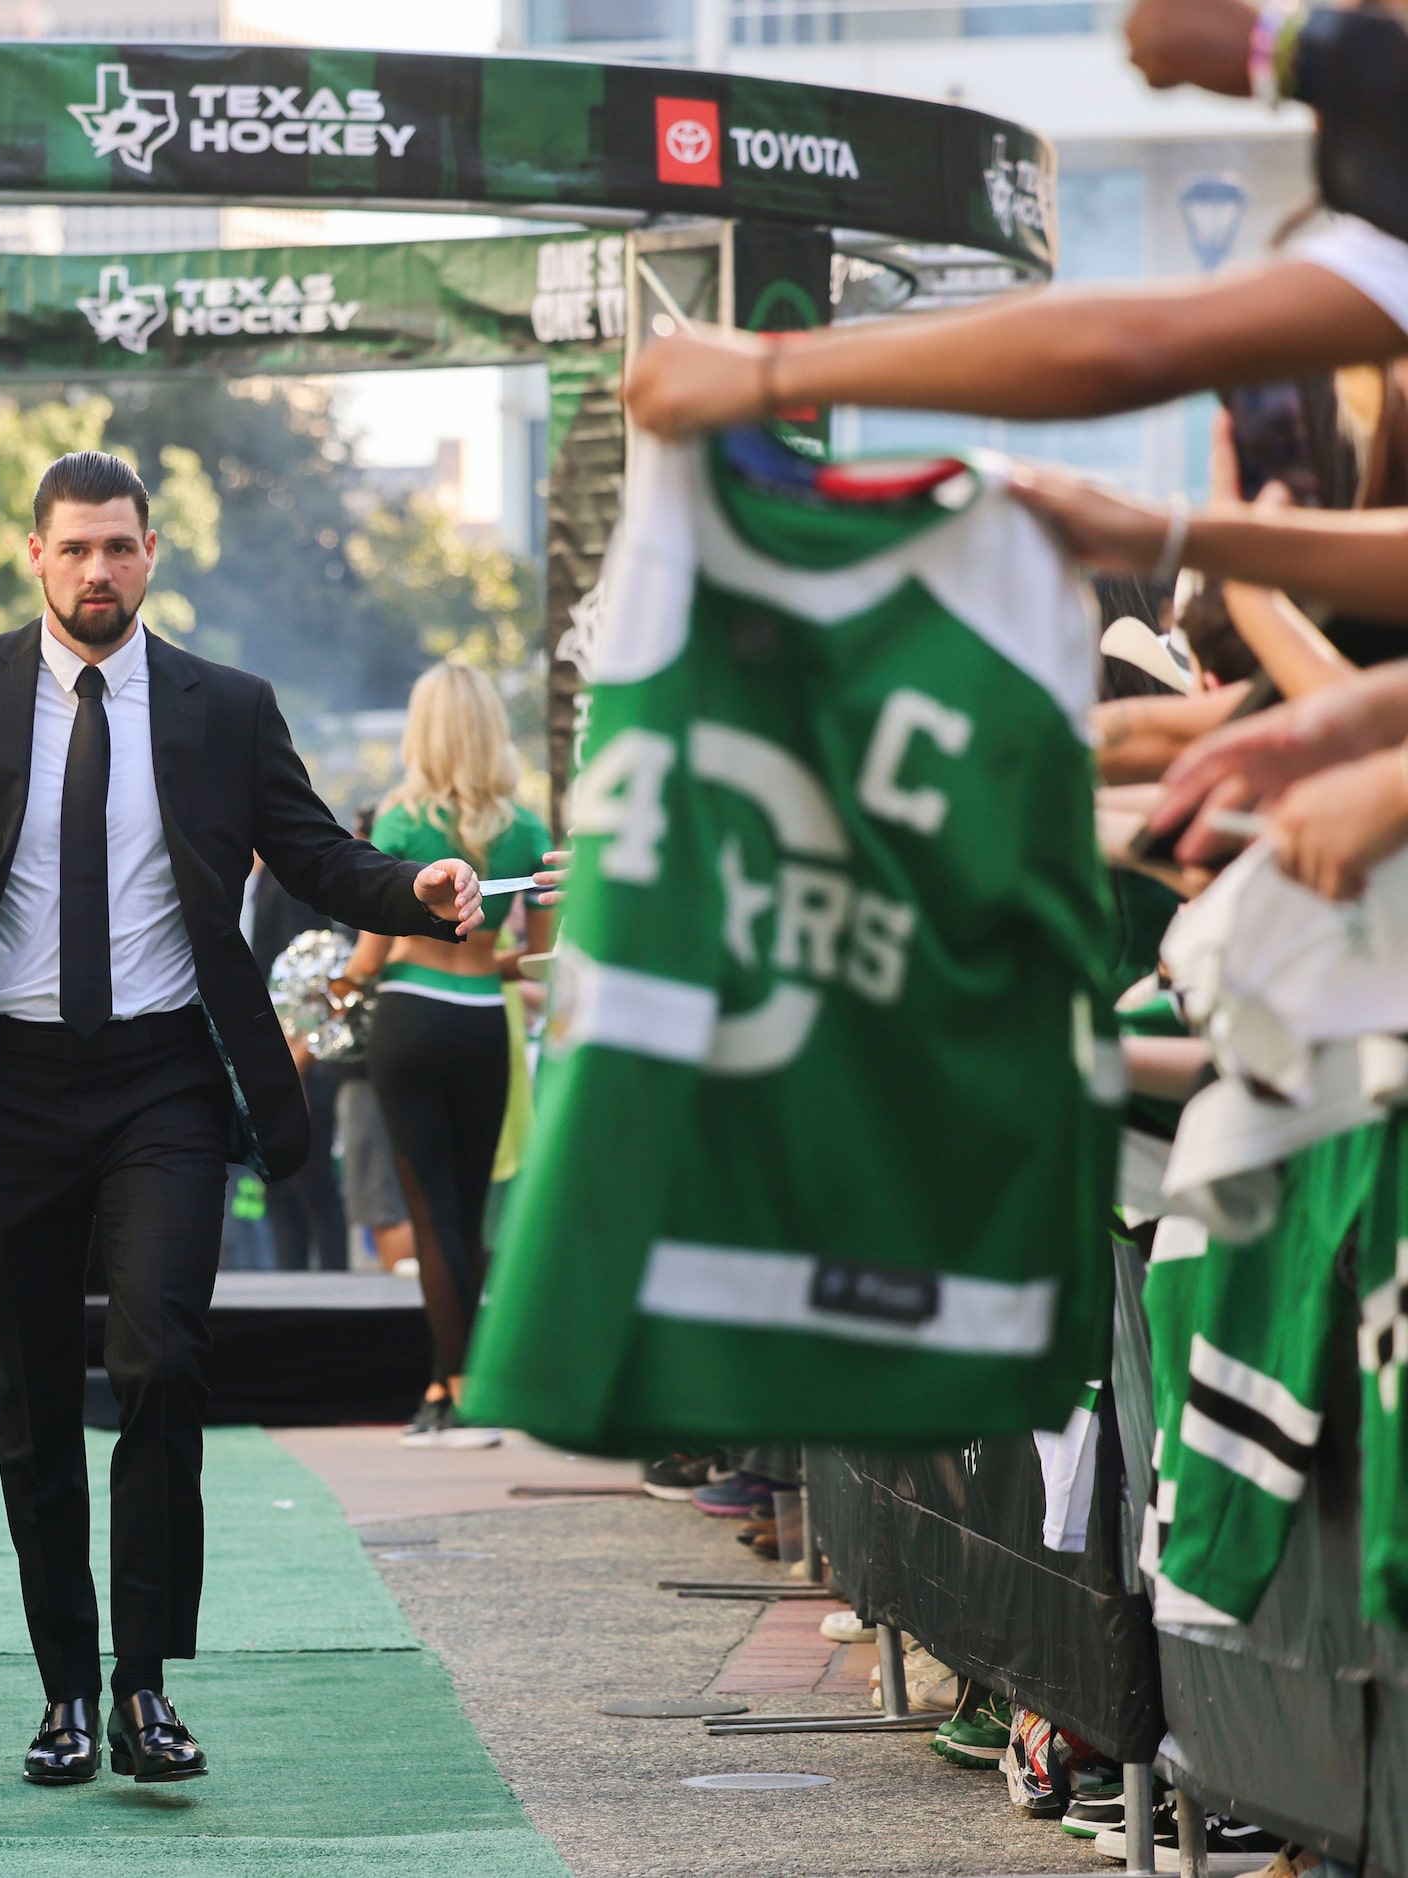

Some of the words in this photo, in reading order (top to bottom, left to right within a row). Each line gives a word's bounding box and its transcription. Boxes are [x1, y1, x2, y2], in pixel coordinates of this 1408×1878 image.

[189, 84, 385, 121] TEXAS
[189, 118, 417, 157] HOCKEY
[730, 126, 859, 181] TOYOTA
[597, 236, 625, 288] S
[173, 273, 336, 306] TEXAS
[173, 301, 361, 337] HOCKEY
[857, 688, 973, 836] C
